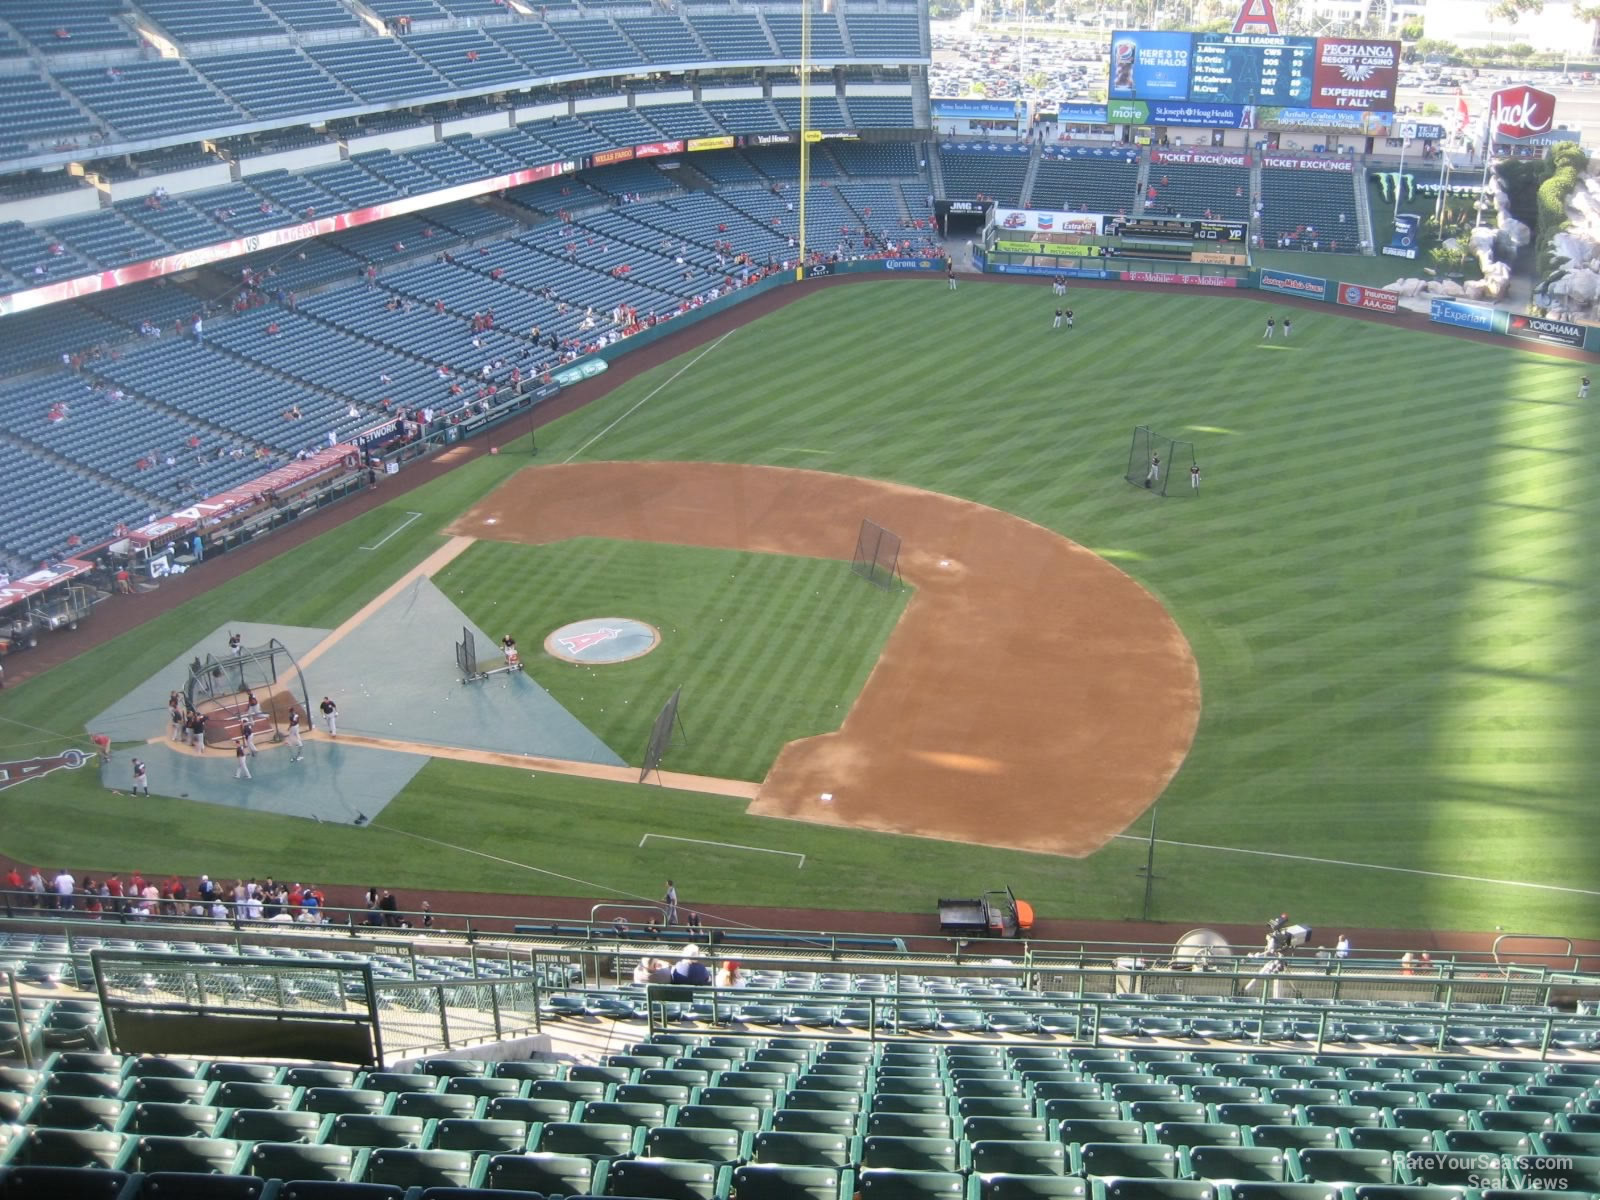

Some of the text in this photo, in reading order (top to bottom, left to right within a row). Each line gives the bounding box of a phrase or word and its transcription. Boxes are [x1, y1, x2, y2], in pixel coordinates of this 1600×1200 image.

[1251, 37, 1285, 45] LEADERS
[1139, 49, 1188, 58] HERE'S TO
[1264, 48, 1282, 56] CWS
[1323, 44, 1394, 57] PECHANGA
[1139, 58, 1187, 67] THE HALOS
[1361, 58, 1393, 66] CASINO
[1195, 66, 1224, 74] M.Trout
[1262, 68, 1277, 76] LAA
[1193, 85, 1219, 93] N.Cruz
[1320, 87, 1388, 98] EXPERIENCE
[1336, 98, 1347, 106] IT
[1112, 110, 1142, 119] more
[1212, 110, 1234, 118] Health
[1284, 110, 1354, 121] Artfully Crafted With
[1298, 119, 1331, 127] California
[1332, 120, 1359, 128] Oranges
[758, 134, 789, 144] Yard House
[1529, 137, 1538, 145] in
[595, 153, 614, 163] WELLS
[614, 149, 632, 161] FARGO
[1158, 153, 1245, 165] TICKET EXCHANGE
[1264, 158, 1352, 170] TICKET EXCHANGE
[950, 202, 972, 211] JMG
[246, 223, 314, 252] VS ANGELS
[1230, 229, 1242, 238] yp
[886, 259, 916, 270] Corona
[1444, 307, 1487, 324] Experian
[1529, 319, 1580, 337] YOKOHAMA
